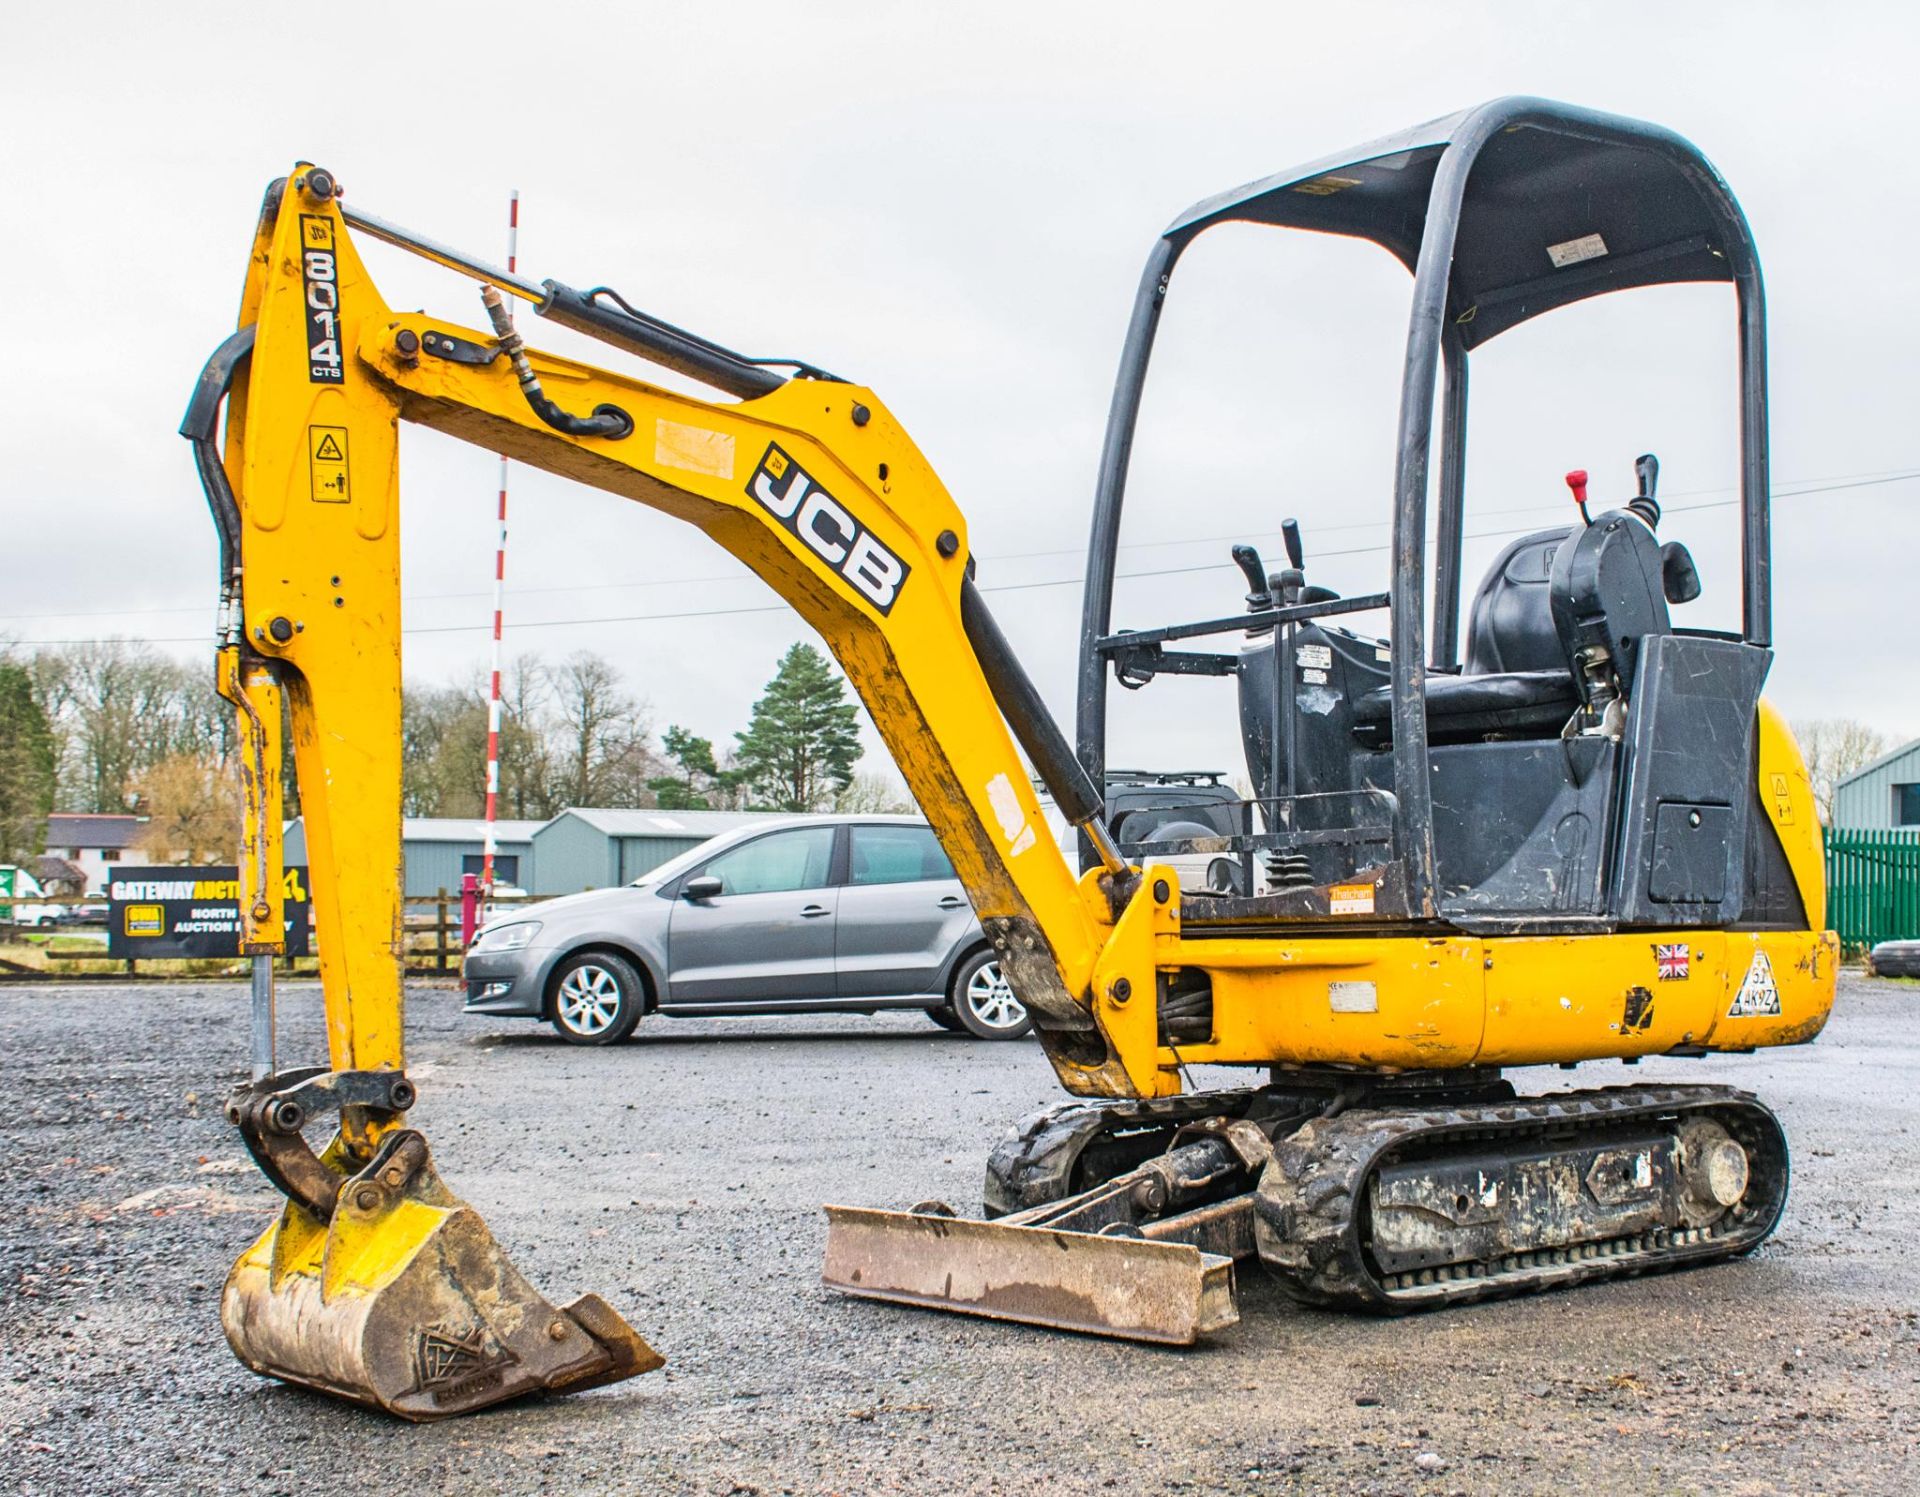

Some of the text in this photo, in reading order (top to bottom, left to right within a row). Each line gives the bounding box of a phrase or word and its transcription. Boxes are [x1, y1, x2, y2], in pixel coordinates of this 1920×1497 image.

[304, 252, 341, 368] 8014
[312, 367, 341, 378] CTS
[754, 471, 903, 607] JCB
[190, 908, 237, 919] NORTH
[174, 922, 232, 932] AUCTION
